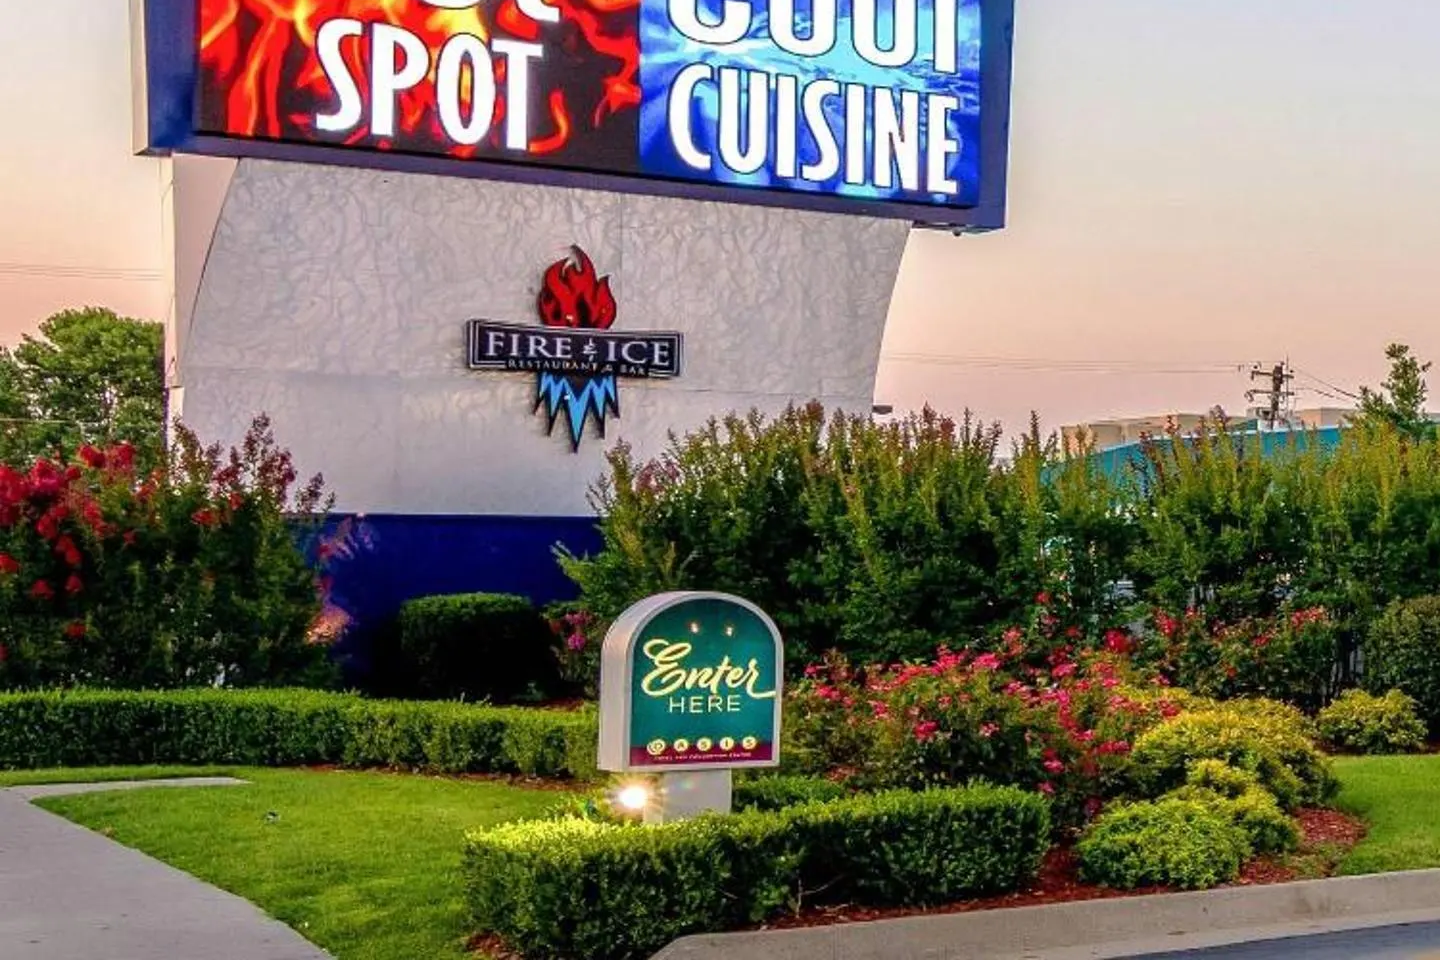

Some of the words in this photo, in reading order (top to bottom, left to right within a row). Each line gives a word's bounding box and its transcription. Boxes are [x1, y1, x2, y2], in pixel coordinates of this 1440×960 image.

[314, 18, 545, 151] SPOT
[666, 60, 961, 196] CUISINE
[484, 331, 573, 358] FIRE
[605, 339, 670, 366] ICE
[641, 638, 777, 698] Enter
[668, 693, 742, 714] HERE
